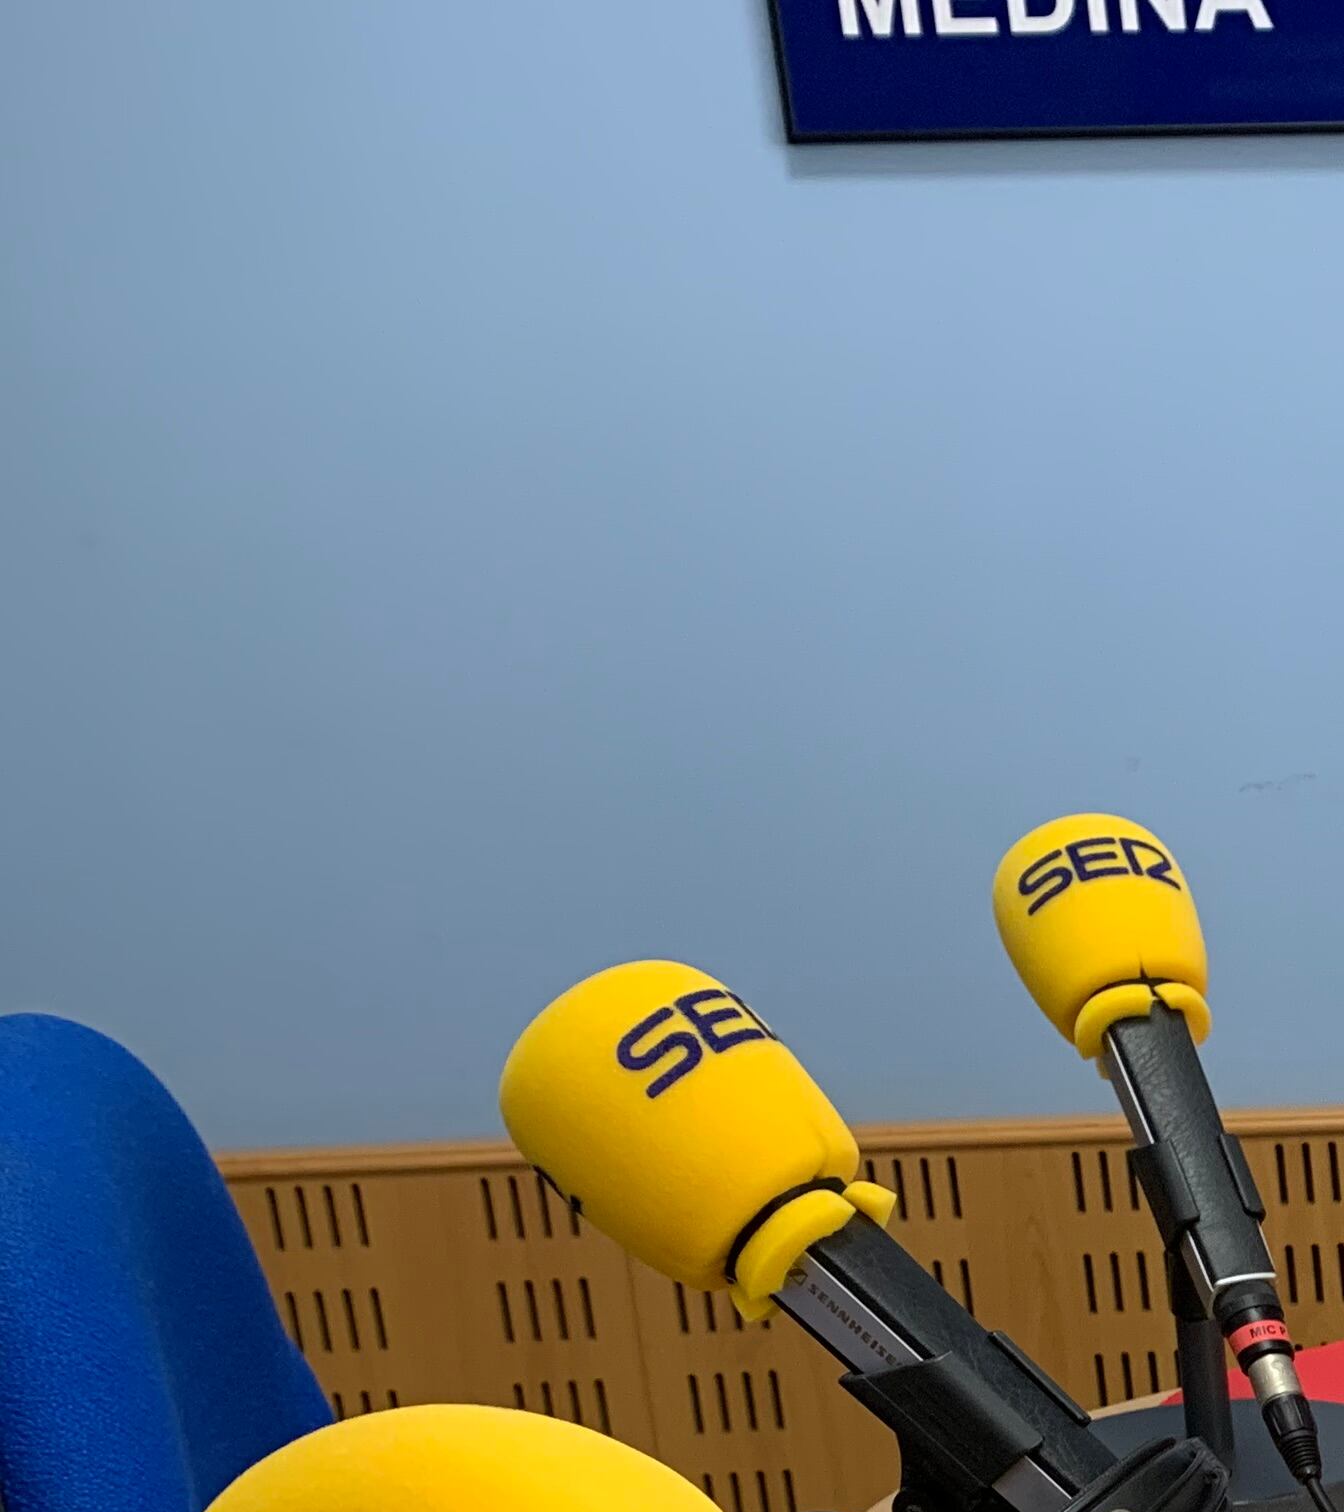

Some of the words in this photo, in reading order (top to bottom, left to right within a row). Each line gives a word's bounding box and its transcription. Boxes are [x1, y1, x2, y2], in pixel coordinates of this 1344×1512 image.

[1018, 837, 1181, 915] SER
[616, 988, 778, 1099] SE
[807, 1283, 903, 1366] SENNHEISE
[1249, 1324, 1277, 1339] MIC
